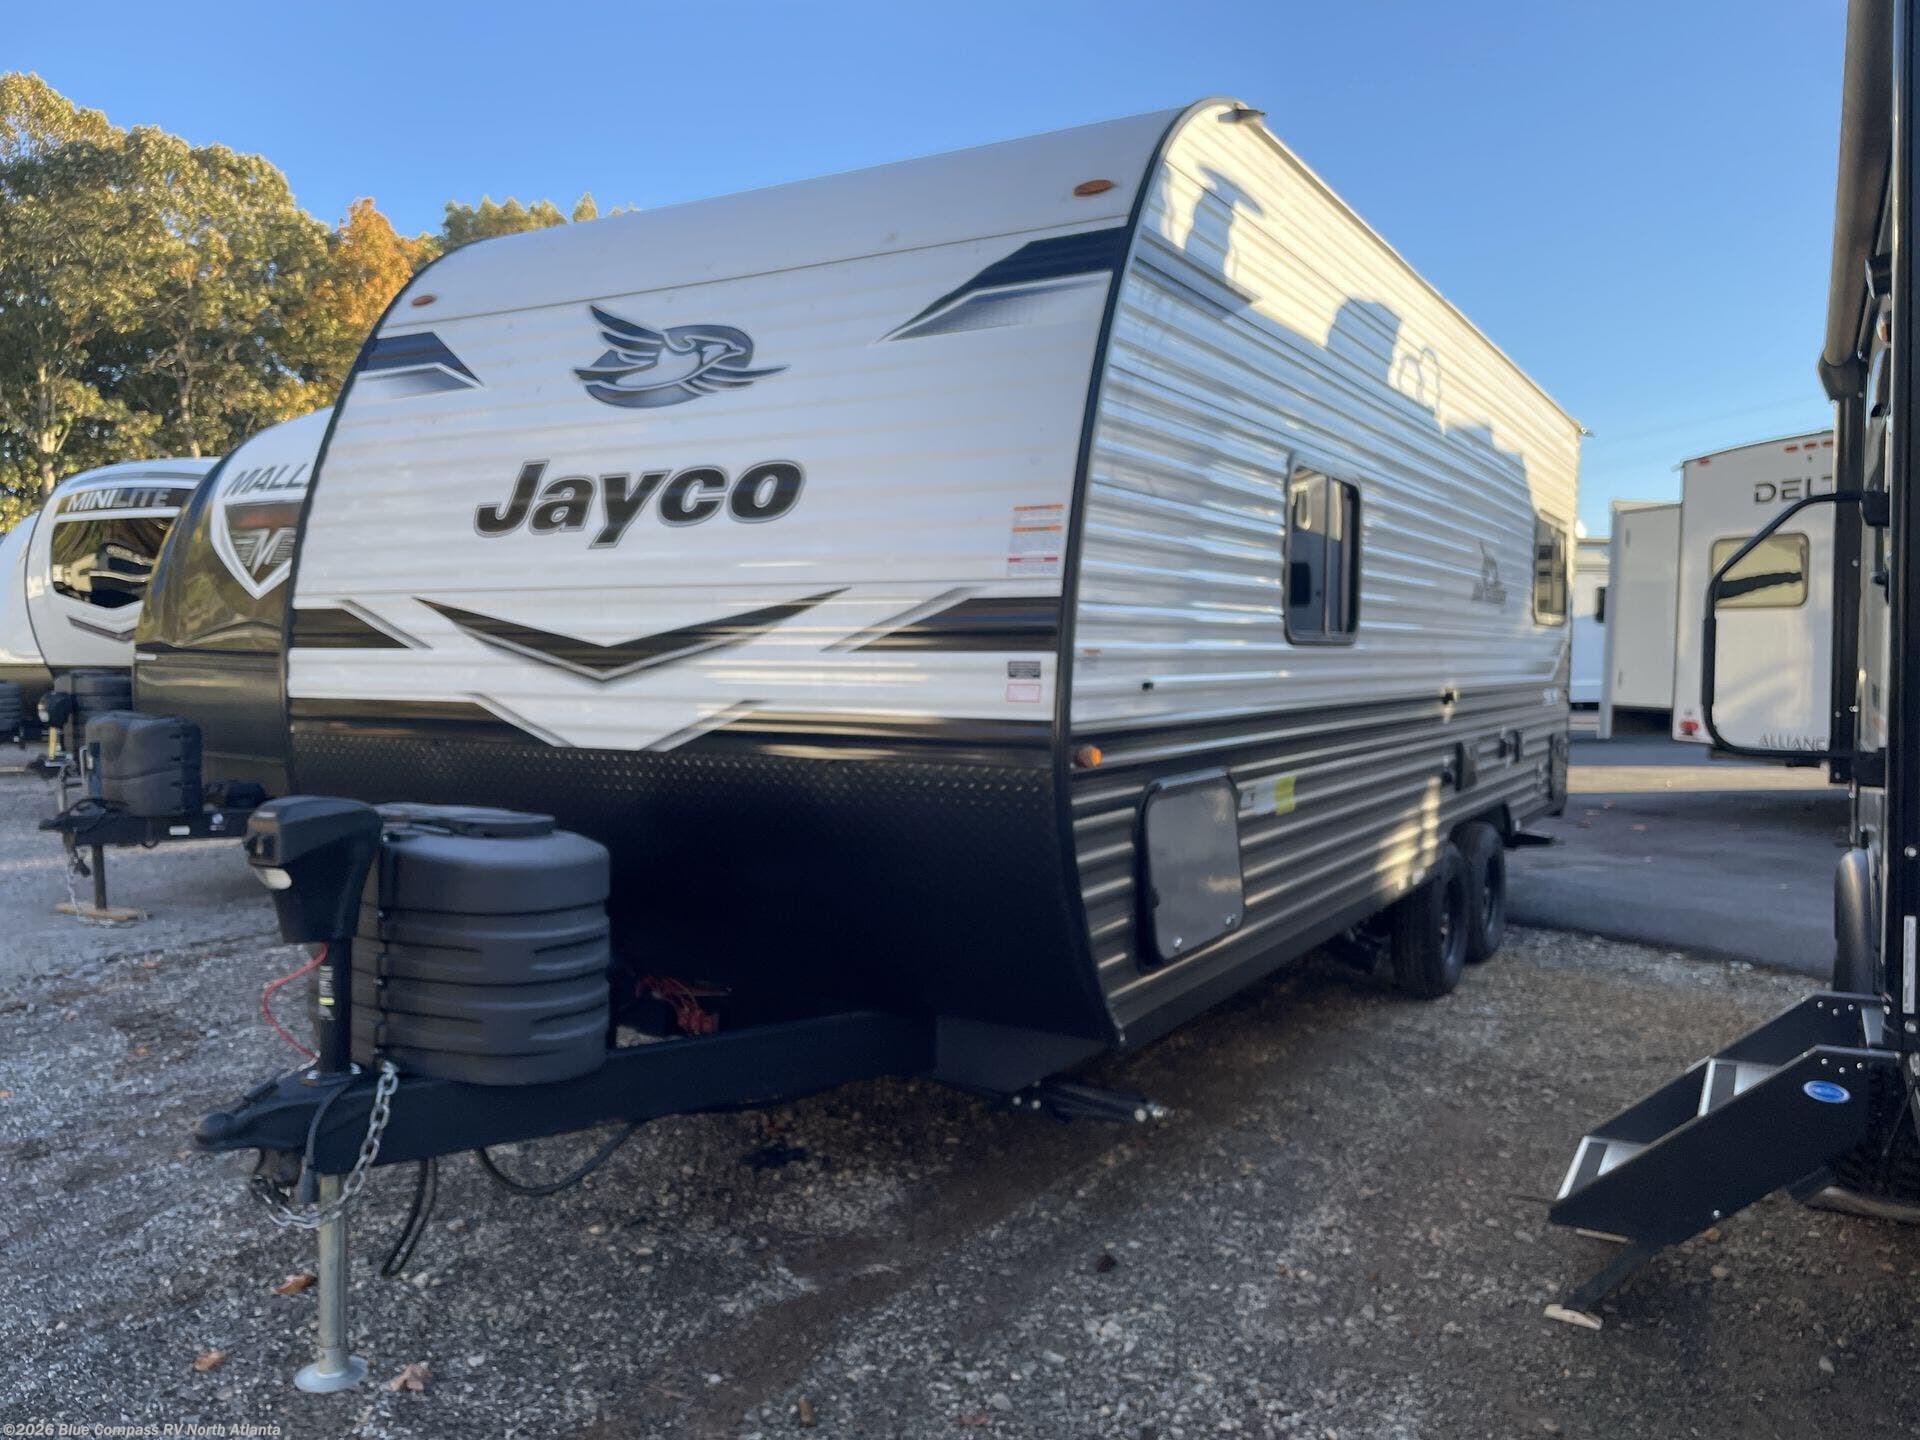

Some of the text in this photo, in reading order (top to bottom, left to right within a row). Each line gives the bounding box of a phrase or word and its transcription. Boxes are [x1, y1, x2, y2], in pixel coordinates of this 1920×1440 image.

[222, 463, 309, 498] MALL
[65, 487, 172, 513] MINILITE
[473, 458, 807, 550] Jayco
